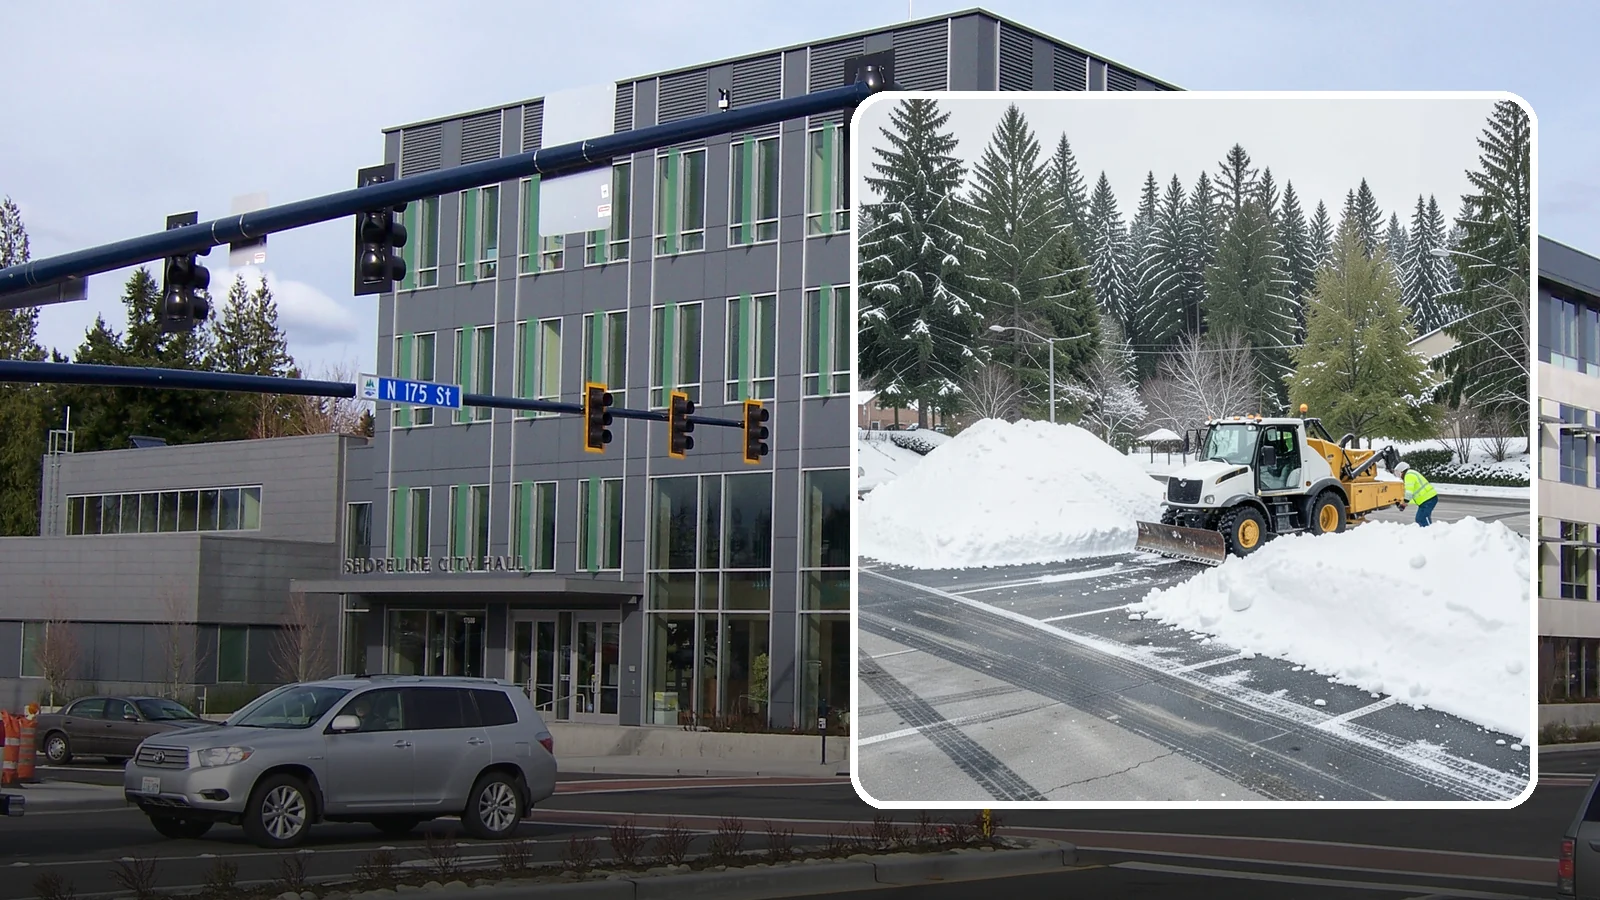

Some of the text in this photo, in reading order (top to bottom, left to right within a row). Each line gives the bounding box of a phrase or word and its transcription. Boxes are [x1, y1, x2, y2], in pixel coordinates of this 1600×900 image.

[387, 380, 451, 406] N 175 St
[344, 554, 525, 573] SHORELINE CITY HALL
